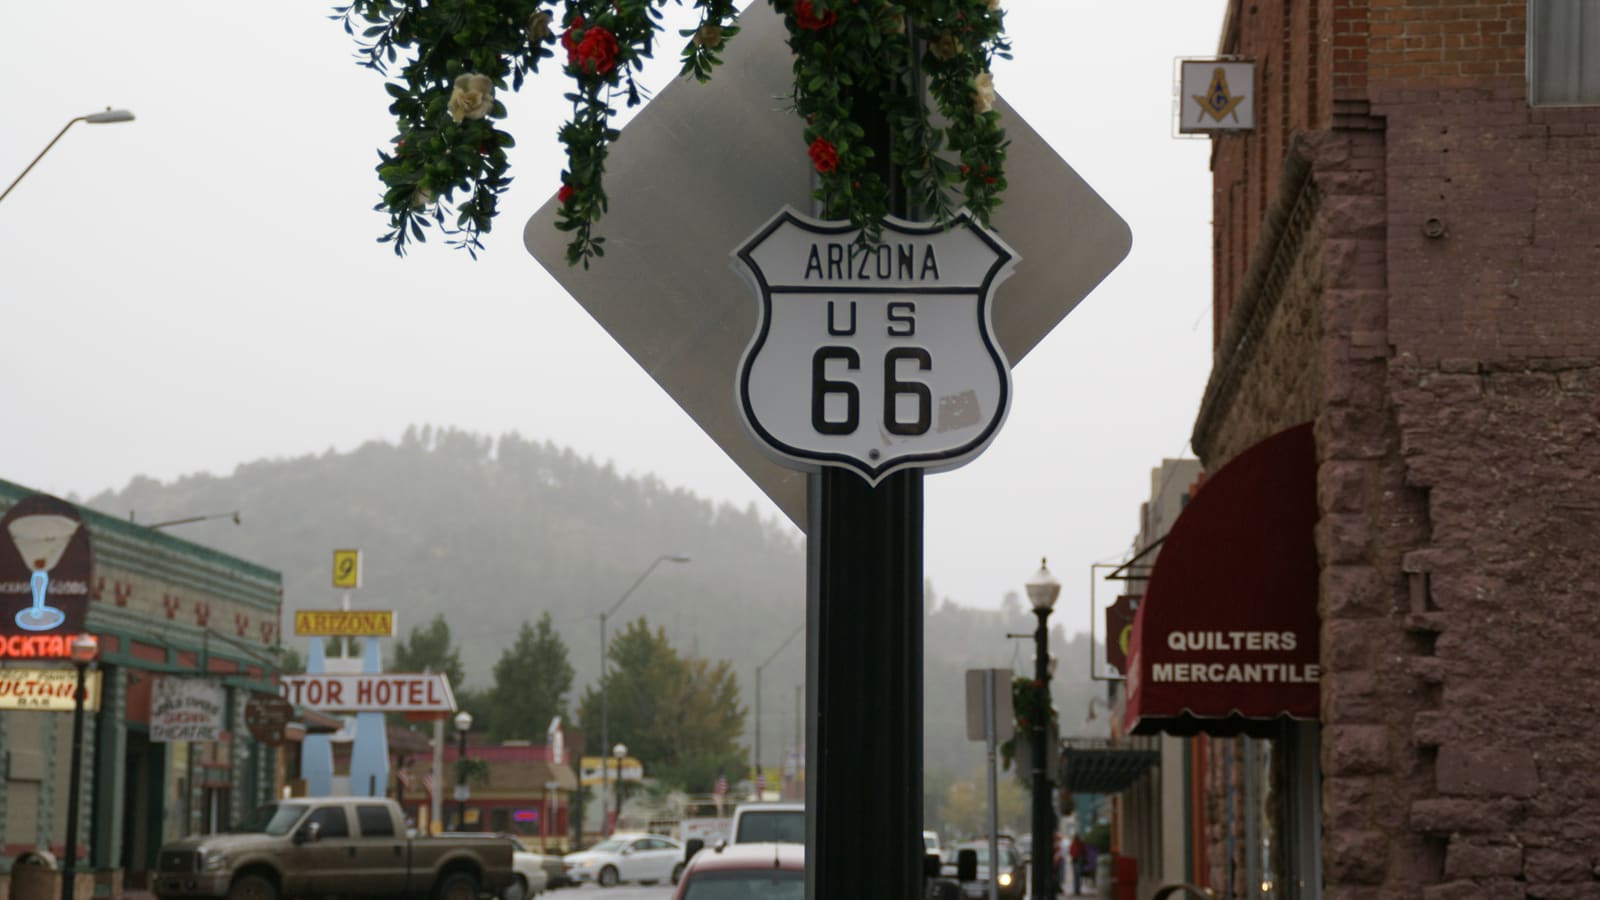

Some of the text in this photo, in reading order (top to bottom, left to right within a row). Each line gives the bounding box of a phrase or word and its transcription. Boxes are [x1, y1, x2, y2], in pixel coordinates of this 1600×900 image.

[804, 243, 940, 280] ARIZONA
[811, 345, 932, 436] 66
[300, 615, 390, 633] ARIZONA
[1167, 631, 1297, 651] QUILTERS
[1152, 663, 1321, 683] MERCANTILE
[356, 680, 441, 705] HOTEL
